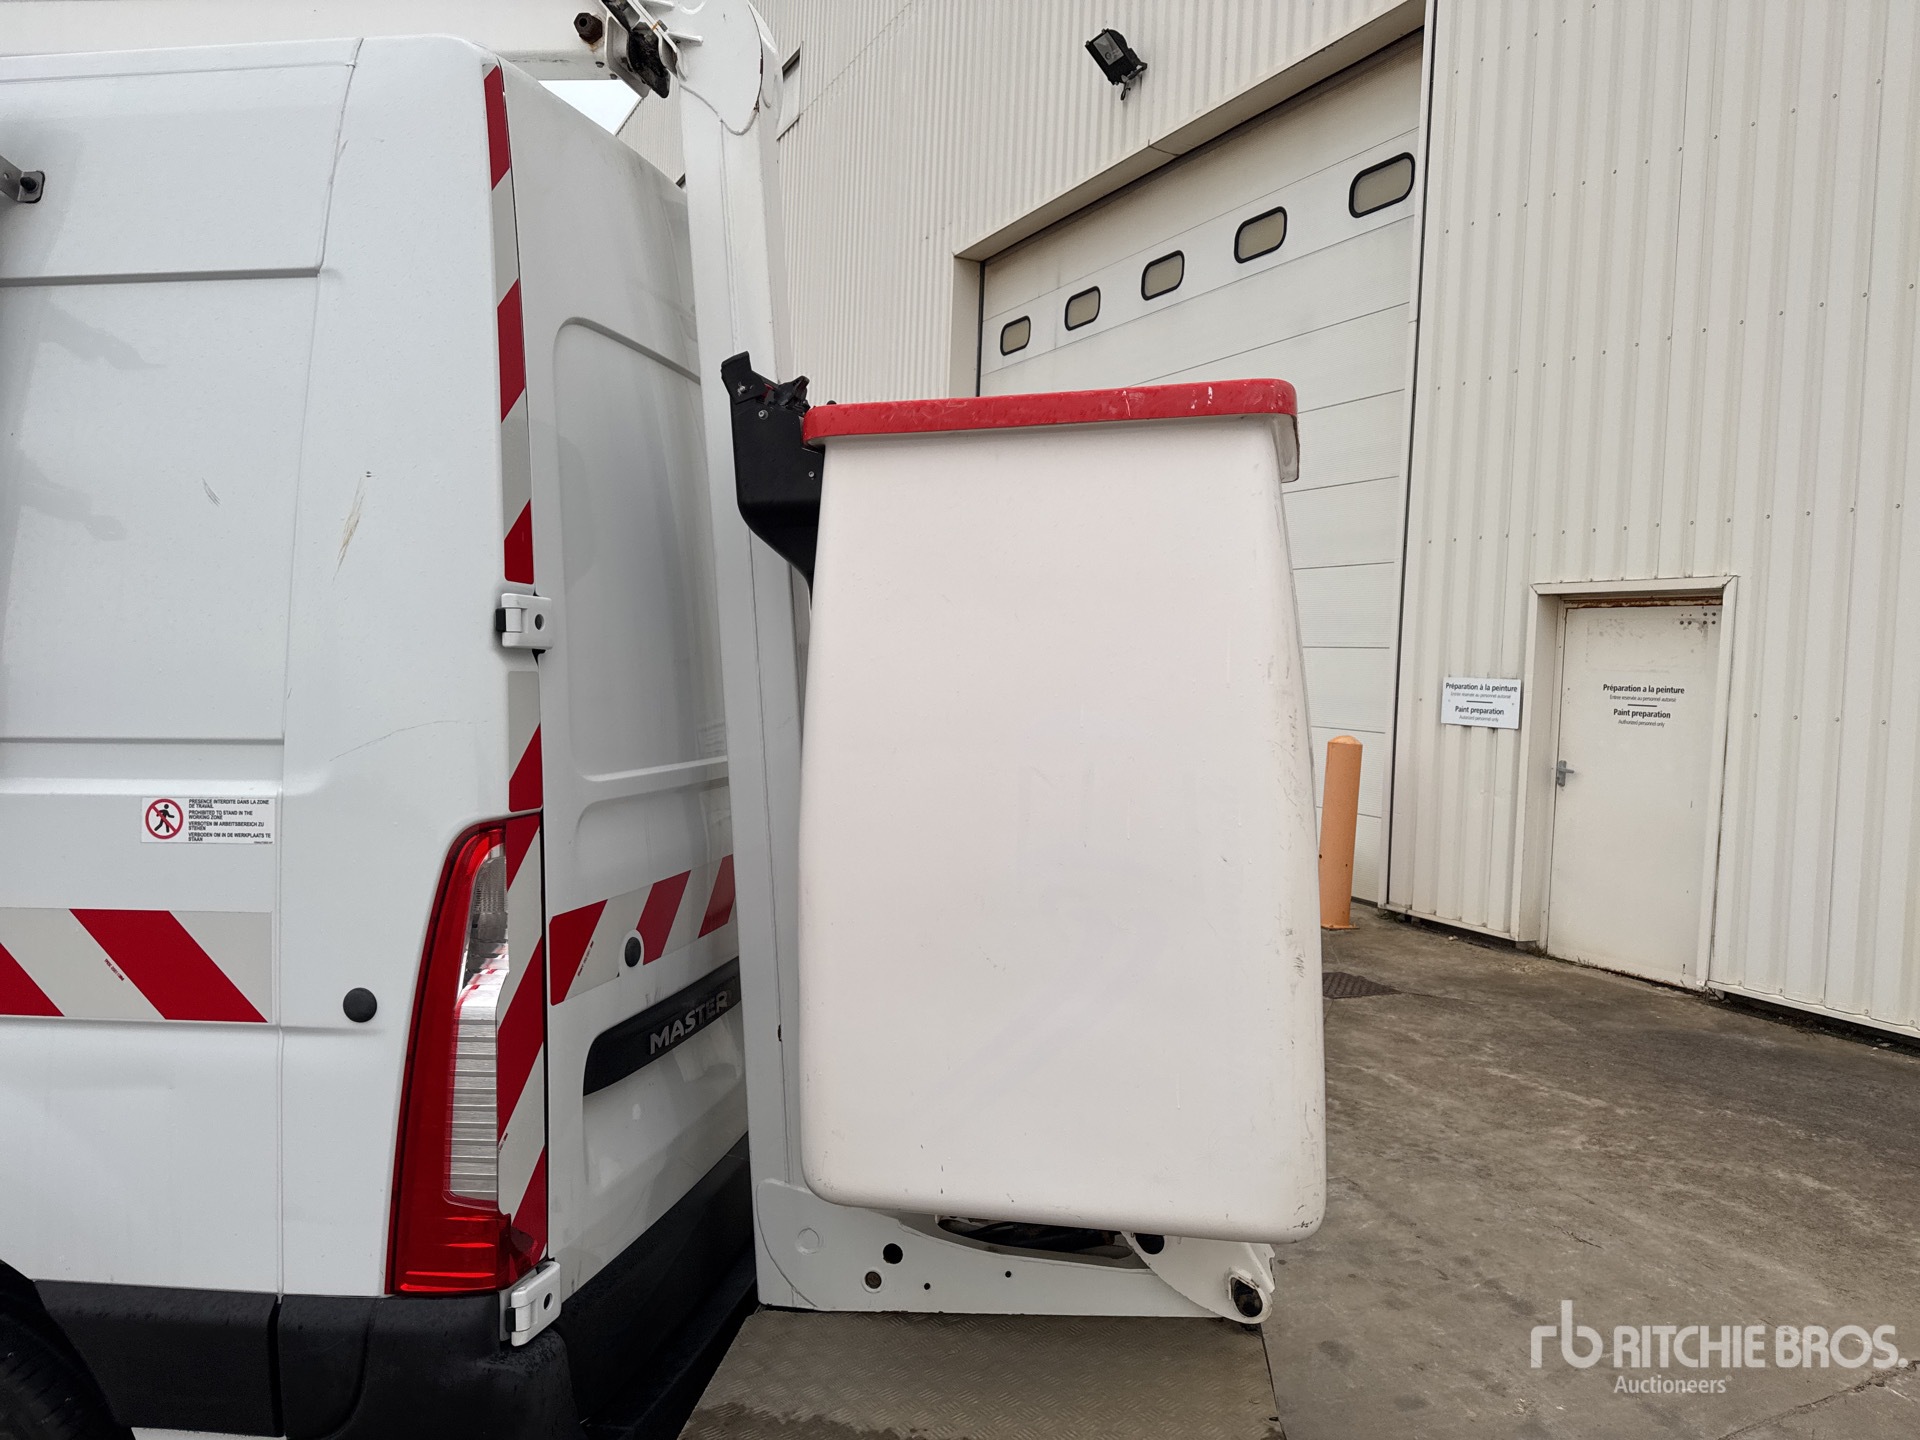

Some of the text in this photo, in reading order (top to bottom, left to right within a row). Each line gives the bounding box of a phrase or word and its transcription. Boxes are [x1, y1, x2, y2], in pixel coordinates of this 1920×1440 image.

[1603, 684, 1641, 692] Préparation
[1656, 686, 1684, 694] peinture
[1470, 707, 1504, 715] preparation
[1614, 708, 1670, 718] Paint preparation
[650, 990, 728, 1054] MASTER
